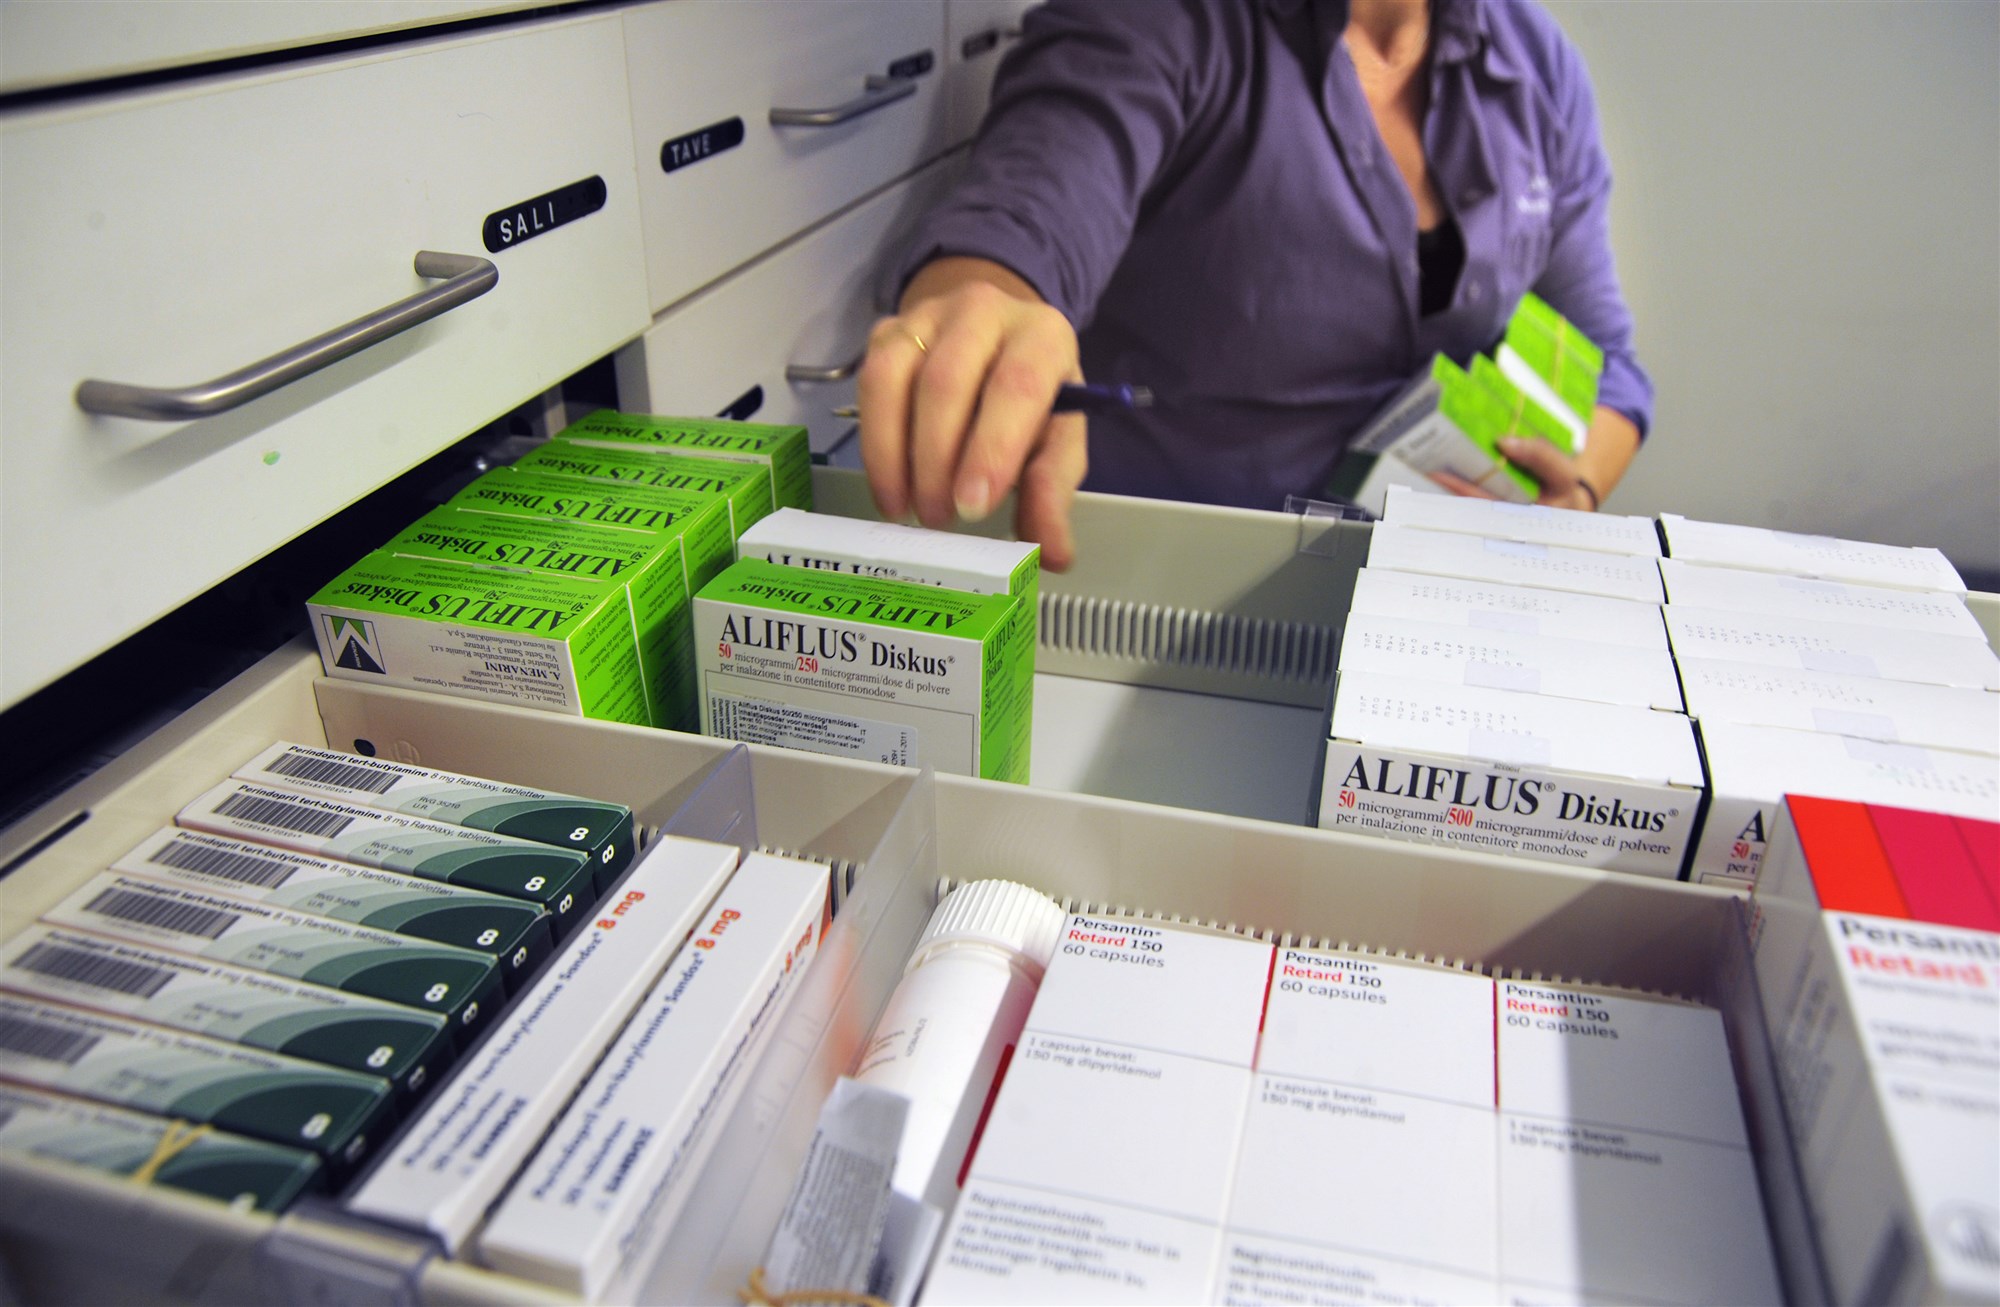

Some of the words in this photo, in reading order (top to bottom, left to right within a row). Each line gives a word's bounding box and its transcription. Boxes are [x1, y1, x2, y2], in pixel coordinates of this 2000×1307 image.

[672, 134, 713, 166] TAVE
[499, 201, 557, 244] SALI
[960, 608, 975, 616] 50
[445, 648, 471, 657] Riunite
[464, 642, 491, 652] Firenze
[505, 648, 523, 657] Santi
[523, 641, 545, 650] licenza
[473, 652, 526, 666] Farmaceutiche
[525, 651, 543, 660] Sette
[545, 654, 558, 662] Via
[485, 662, 547, 679] MENARINI
[528, 660, 559, 670] Industrie
[719, 644, 732, 659] 50
[735, 653, 818, 674] microgrammi/250
[821, 667, 903, 688] microgrammi/dose
[905, 676, 914, 690] di
[916, 679, 950, 696] polvere
[413, 677, 447, 686] Operations
[462, 676, 503, 688] Luxembourg
[515, 677, 563, 690] Concessionario
[550, 671, 560, 681] A.
[720, 663, 734, 674] per
[736, 664, 781, 682] inalazione
[783, 671, 792, 682] in
[795, 673, 845, 692] contenitore
[848, 682, 895, 699] monodose
[448, 682, 488, 694] International
[489, 689, 518, 697] Menarini
[525, 686, 566, 698] Luxembourg
[543, 696, 567, 706] Titolare
[760, 705, 780, 714] Diskus
[288, 745, 347, 762] Perindopril
[348, 757, 429, 778] tert-butylamine
[439, 773, 455, 784] mg
[457, 776, 499, 793] Ranbaxy,
[502, 784, 545, 800] tabletten
[419, 796, 436, 805] RVG
[436, 798, 461, 810] 35210
[237, 784, 297, 803] Perindopril
[298, 795, 382, 821] tert-butylamine
[384, 812, 393, 822] 8
[393, 814, 409, 826] mg
[410, 817, 455, 835] Ranbaxy,
[456, 829, 501, 845] tabletten
[1338, 791, 1355, 809] 50
[1358, 800, 1473, 827] microgrammi/500
[1475, 819, 1599, 846] microgrammi/dose
[1603, 832, 1615, 848] di
[1619, 838, 1671, 856] polvere
[569, 826, 590, 842] 8
[1336, 812, 1357, 826] per
[1361, 815, 1428, 836] inalazione
[1432, 826, 1444, 838] in
[1448, 828, 1518, 849] contenitore
[1522, 840, 1588, 859] monodose
[371, 841, 387, 850] RVG
[602, 844, 615, 864] 8
[1730, 842, 1750, 860] 50
[176, 831, 238, 854] Perindopril
[239, 846, 328, 871] tert-butylamine
[329, 863, 339, 873] 8
[340, 865, 358, 877] mg
[409, 879, 454, 897] tabletten
[1726, 862, 1748, 875] per
[524, 876, 546, 892] 8
[559, 894, 573, 914] 8
[597, 916, 617, 930] 8
[613, 890, 645, 917] mg
[477, 928, 500, 946] 8
[698, 933, 716, 951] 8
[709, 907, 742, 937] mg
[1068, 929, 1125, 947] Retard
[1131, 940, 1163, 952] 150
[512, 946, 527, 966] 8
[1063, 944, 1084, 955] 60
[1090, 949, 1164, 968] capsules
[1846, 945, 1987, 988] Retard
[1283, 964, 1342, 983] Retard
[1348, 975, 1382, 989] 150
[424, 983, 448, 1003] 8
[1280, 980, 1303, 994] 60
[1308, 983, 1387, 1005] capsules
[1506, 999, 1569, 1017] Retard
[1575, 1008, 1609, 1023] 150
[1507, 1014, 1530, 1028] 60
[1536, 1018, 1618, 1040] capsules
[1030, 1037, 1035, 1046] 1
[1040, 1039, 1091, 1054] capsule
[366, 1046, 394, 1068] 8
[1026, 1049, 1050, 1061] 150
[1054, 1054, 1074, 1066] mg
[1078, 1058, 1162, 1079] dipyridamol
[1275, 1081, 1329, 1099] capsule
[1261, 1091, 1288, 1107] 150
[1291, 1095, 1314, 1111] mg
